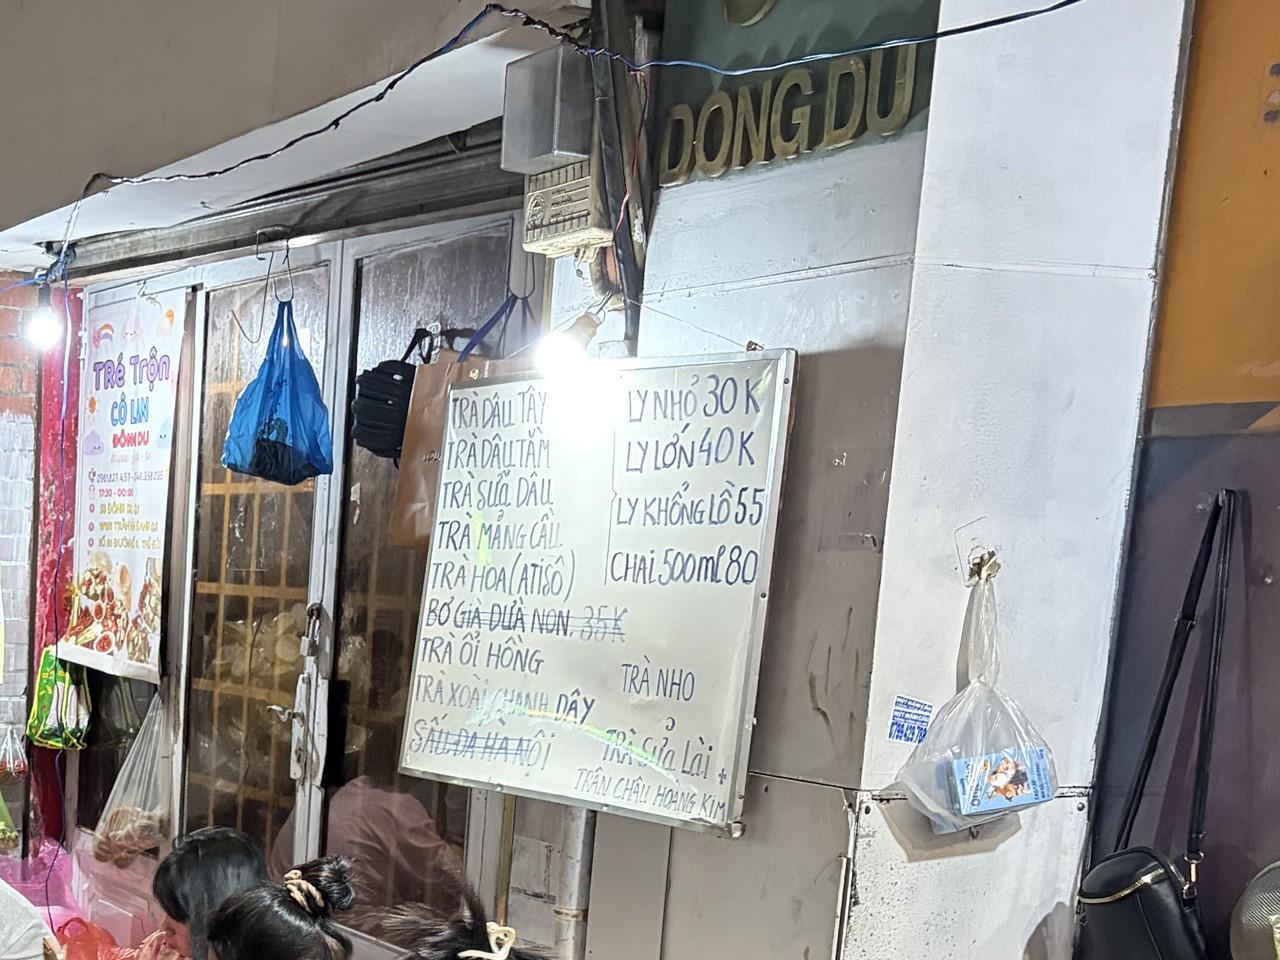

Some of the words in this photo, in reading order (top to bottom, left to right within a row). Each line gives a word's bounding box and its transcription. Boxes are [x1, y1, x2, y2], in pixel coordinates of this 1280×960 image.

[822, 43, 917, 151] DU
[111, 391, 127, 427] CÔ
[452, 391, 479, 429] TRÀ
[482, 391, 515, 429] DÂU
[517, 385, 547, 425] TÂY
[628, 390, 648, 423] LY
[654, 374, 700, 421] NHỎ
[447, 432, 477, 470] TRÀ
[481, 433, 516, 469] DÂU
[626, 441, 648, 474] LY
[654, 422, 695, 471] LỚN
[443, 471, 475, 509] TRÀ
[516, 471, 554, 508] DÂU
[616, 497, 638, 525] LY
[643, 481, 706, 526] KHỔNG
[708, 480, 735, 525] LỒ
[734, 486, 765, 526] 55
[438, 511, 473, 551] TRÀ
[530, 507, 563, 550] CẦU
[432, 553, 470, 590] TRÀ
[470, 565, 507, 593] HOA
[725, 545, 758, 585] 80
[426, 596, 454, 627] BƠ
[421, 632, 456, 665] TRÀ
[486, 635, 545, 675] HỒNG
[415, 670, 446, 705] TRÀ
[555, 687, 595, 725] DÂY
[621, 654, 651, 697] TRÀ
[656, 668, 695, 701] NHO
[613, 776, 651, 804] CHÂU
